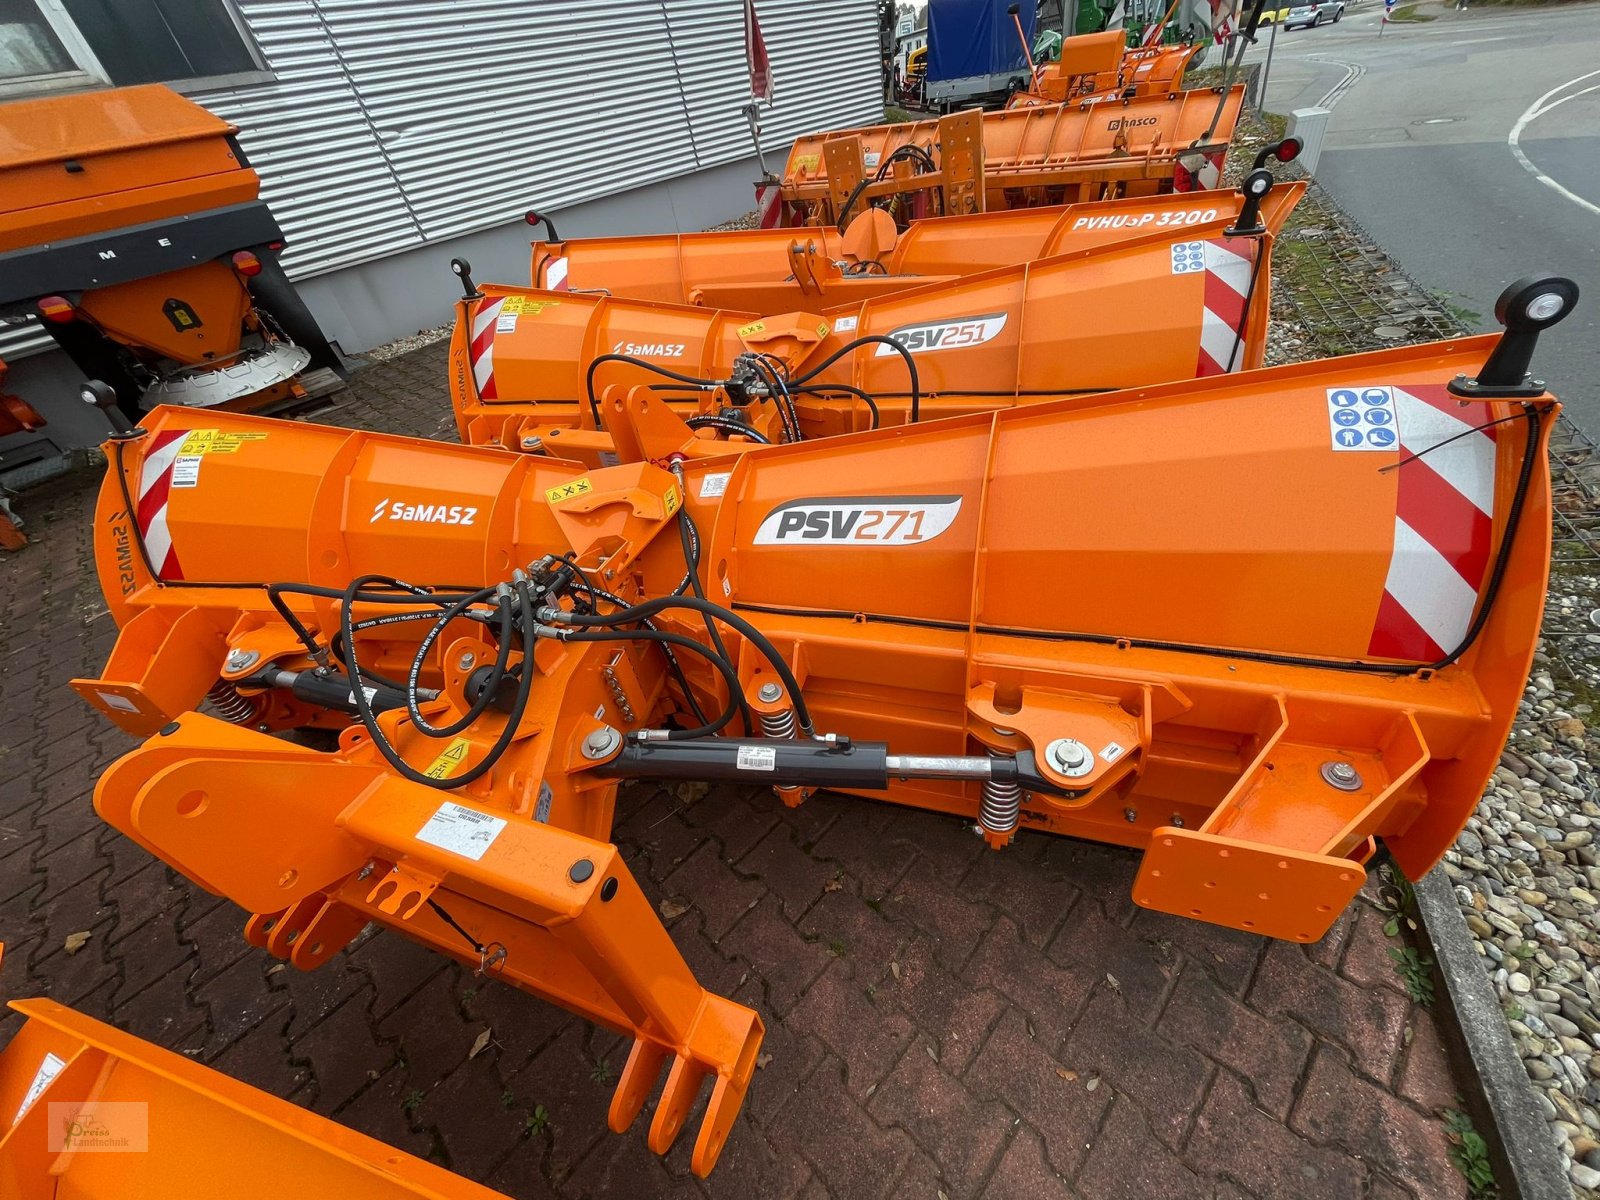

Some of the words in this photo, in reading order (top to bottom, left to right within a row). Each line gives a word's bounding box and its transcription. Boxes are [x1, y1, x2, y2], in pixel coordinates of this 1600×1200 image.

[1155, 209, 1218, 226] 3200
[98, 250, 117, 260] M
[889, 323, 986, 352] PSV251
[624, 343, 685, 356] SaMASZ
[389, 502, 478, 525] SaMASZ
[776, 510, 926, 540] PSV271
